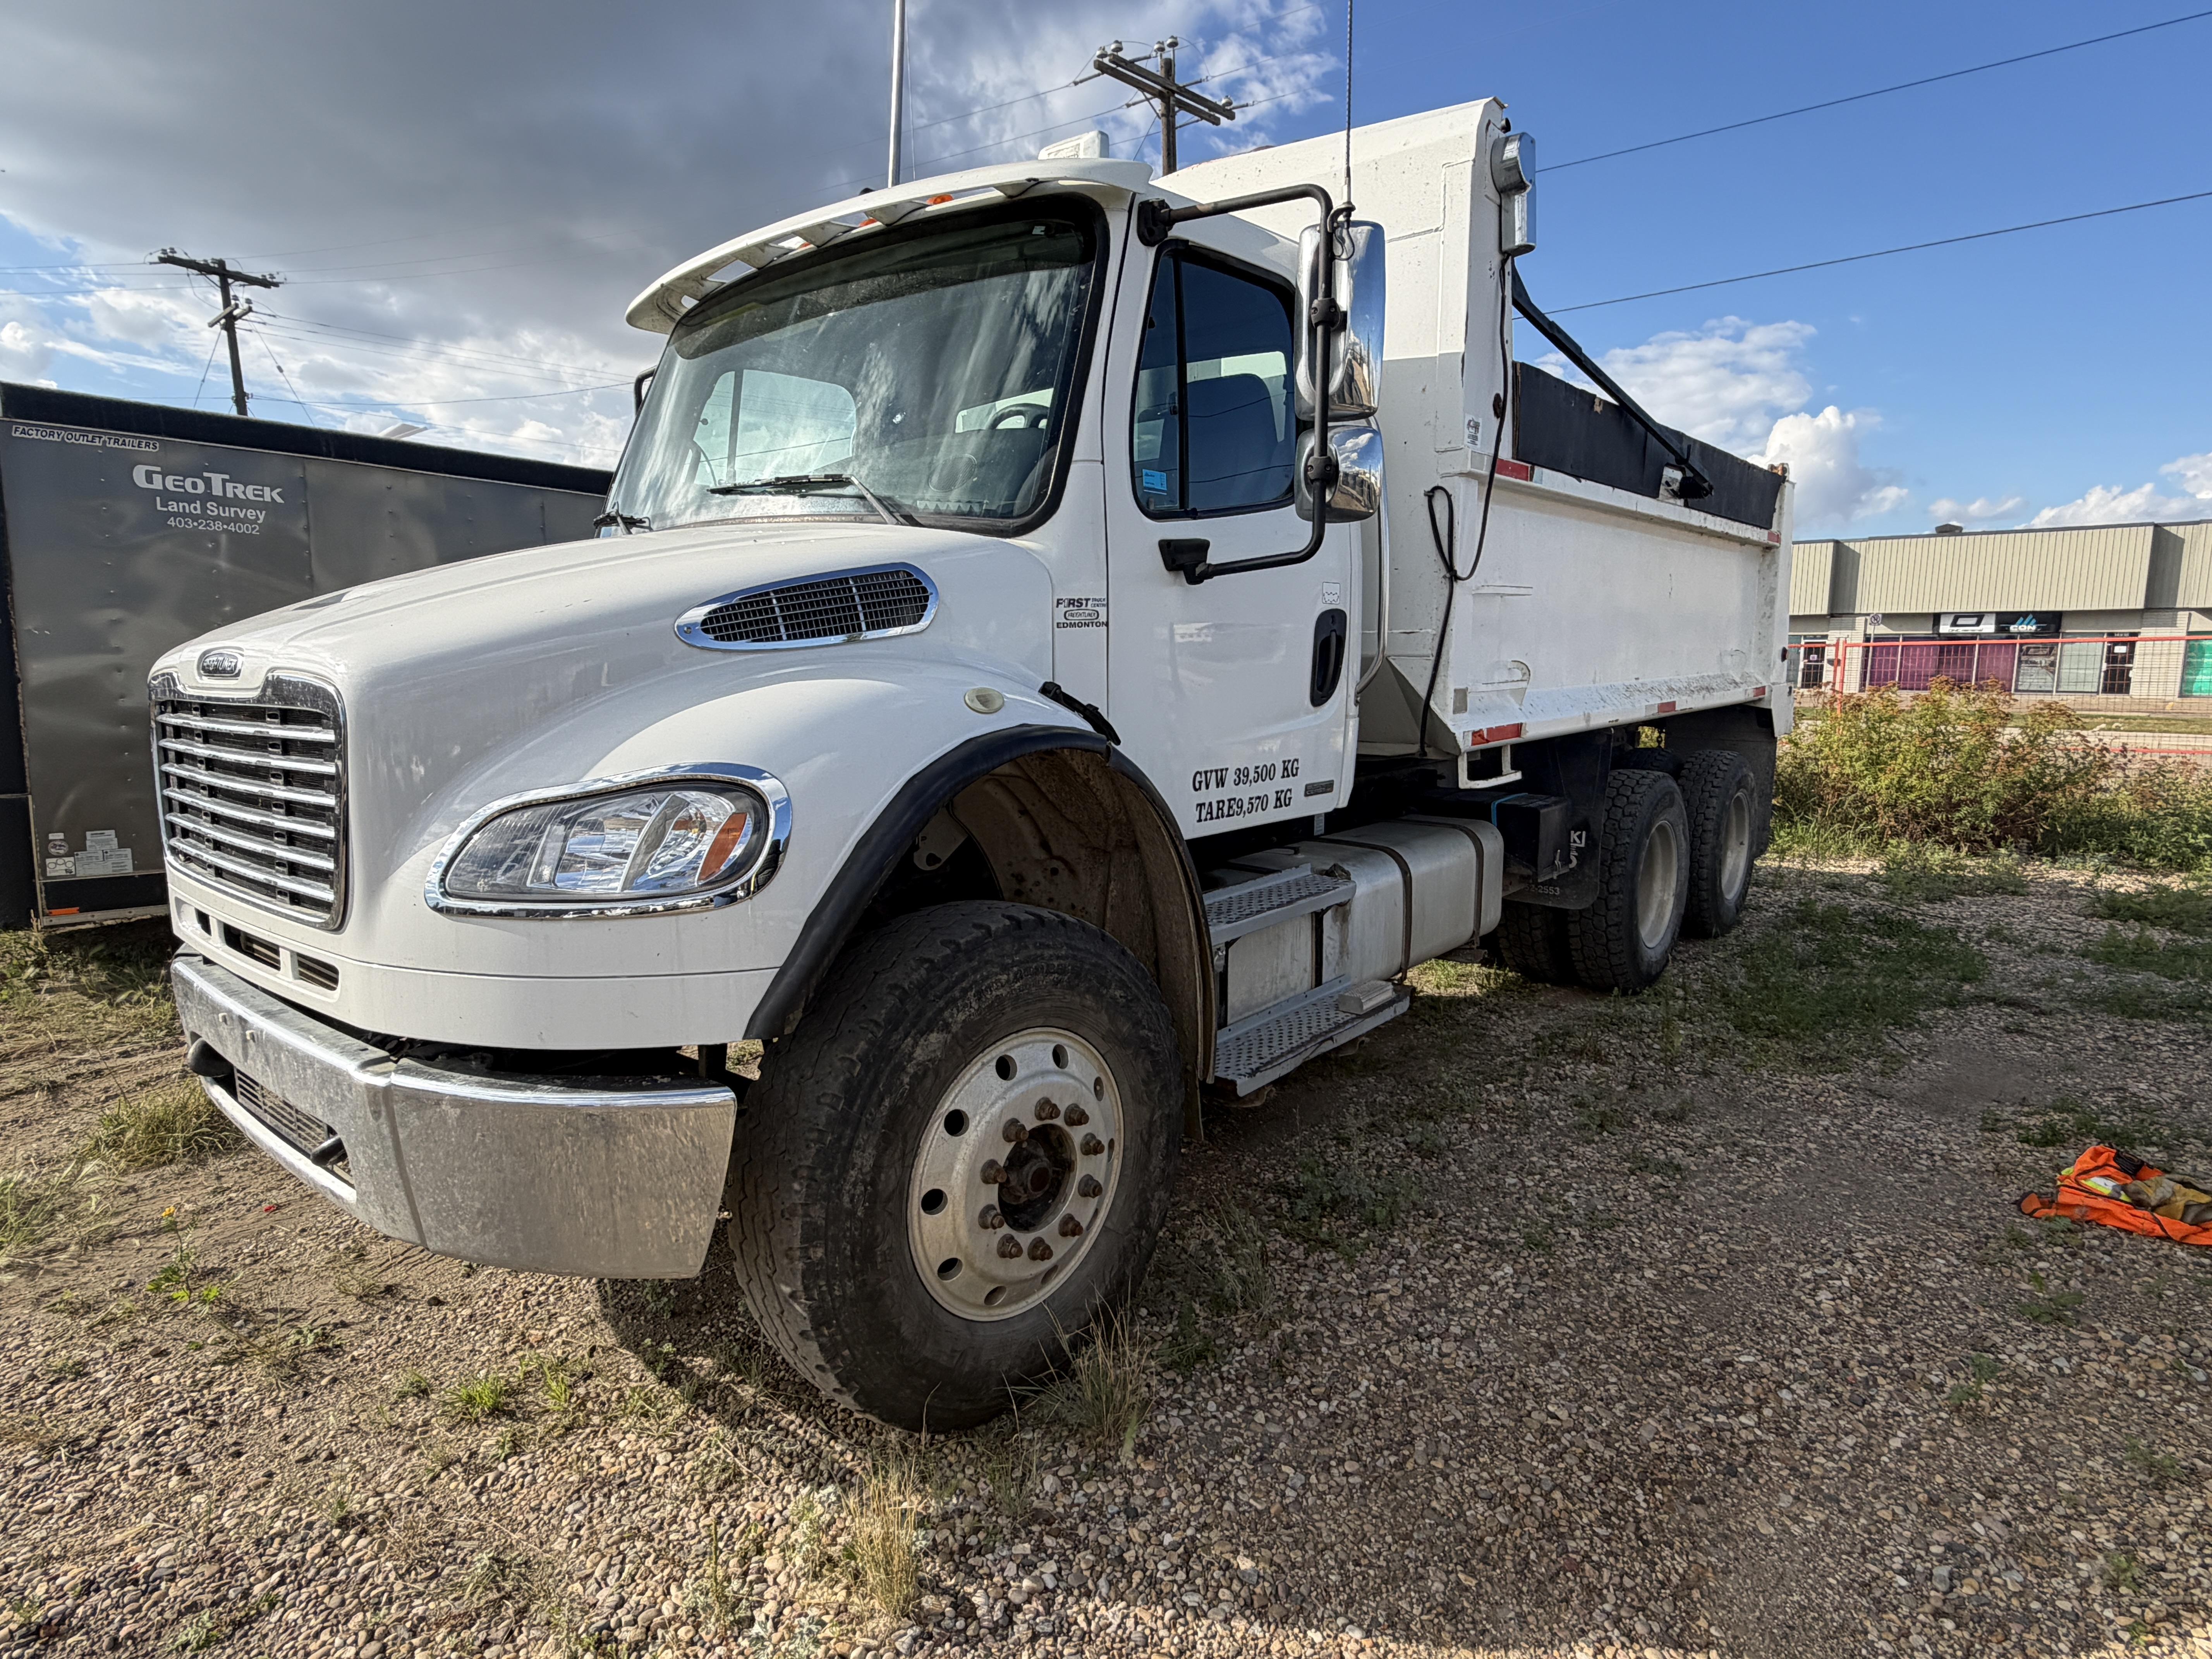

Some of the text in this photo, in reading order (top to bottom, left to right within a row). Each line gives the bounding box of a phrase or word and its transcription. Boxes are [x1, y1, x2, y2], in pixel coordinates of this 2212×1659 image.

[13, 426, 158, 450] FACTORY OUTLET TRAILERS
[156, 496, 266, 523] Land Survey
[1192, 758, 1299, 792] GVW 39,500 KG
[1273, 788, 1293, 809] KG
